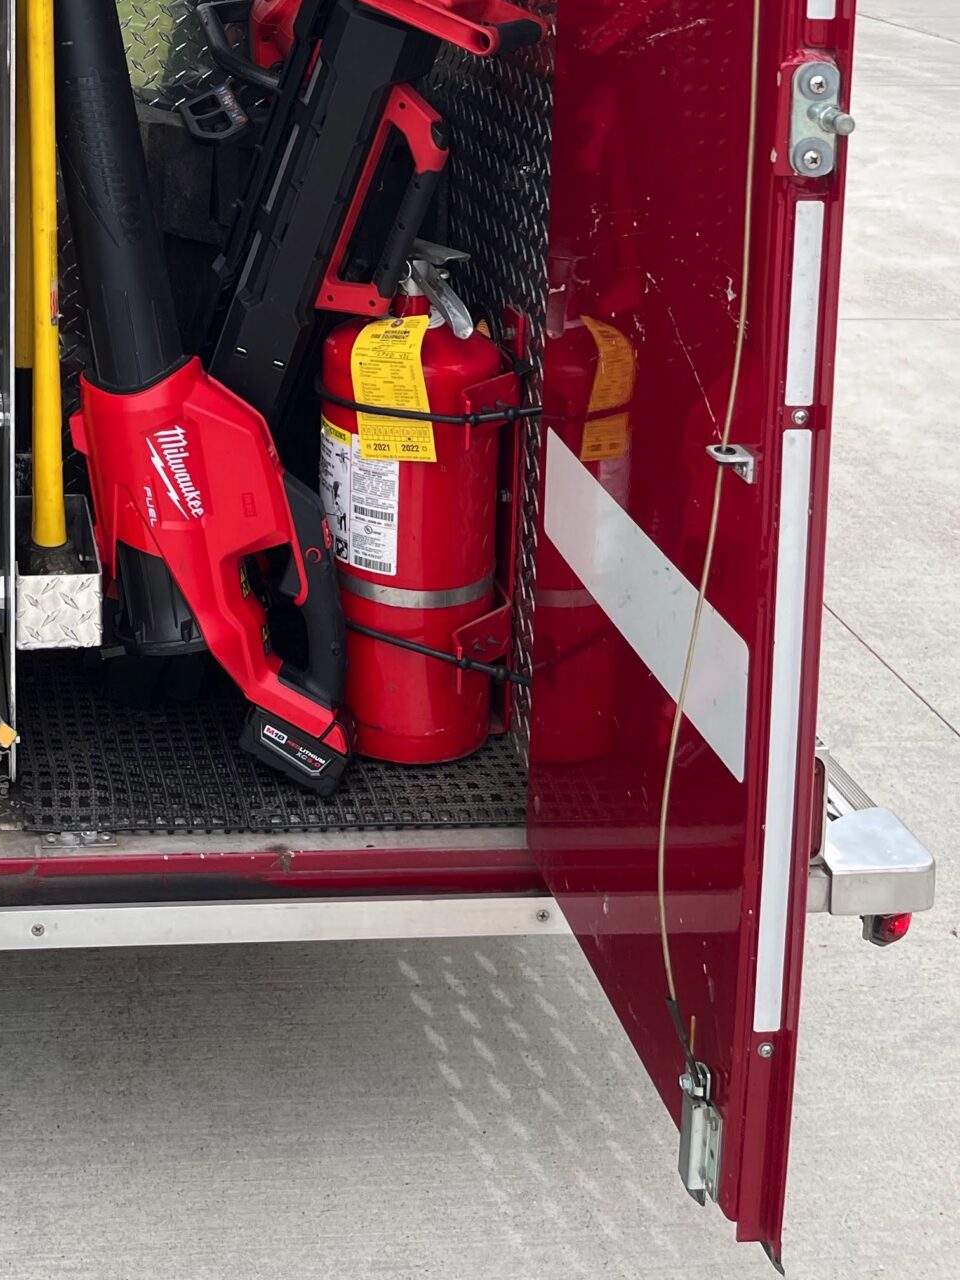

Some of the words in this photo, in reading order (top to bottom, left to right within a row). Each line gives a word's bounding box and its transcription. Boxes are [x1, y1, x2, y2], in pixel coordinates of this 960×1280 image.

[373, 443, 390, 451] 2021
[401, 444, 420, 452] 2022
[153, 424, 206, 519] Milwaukee
[143, 486, 157, 527] FUEL
[265, 726, 286, 742] M18
